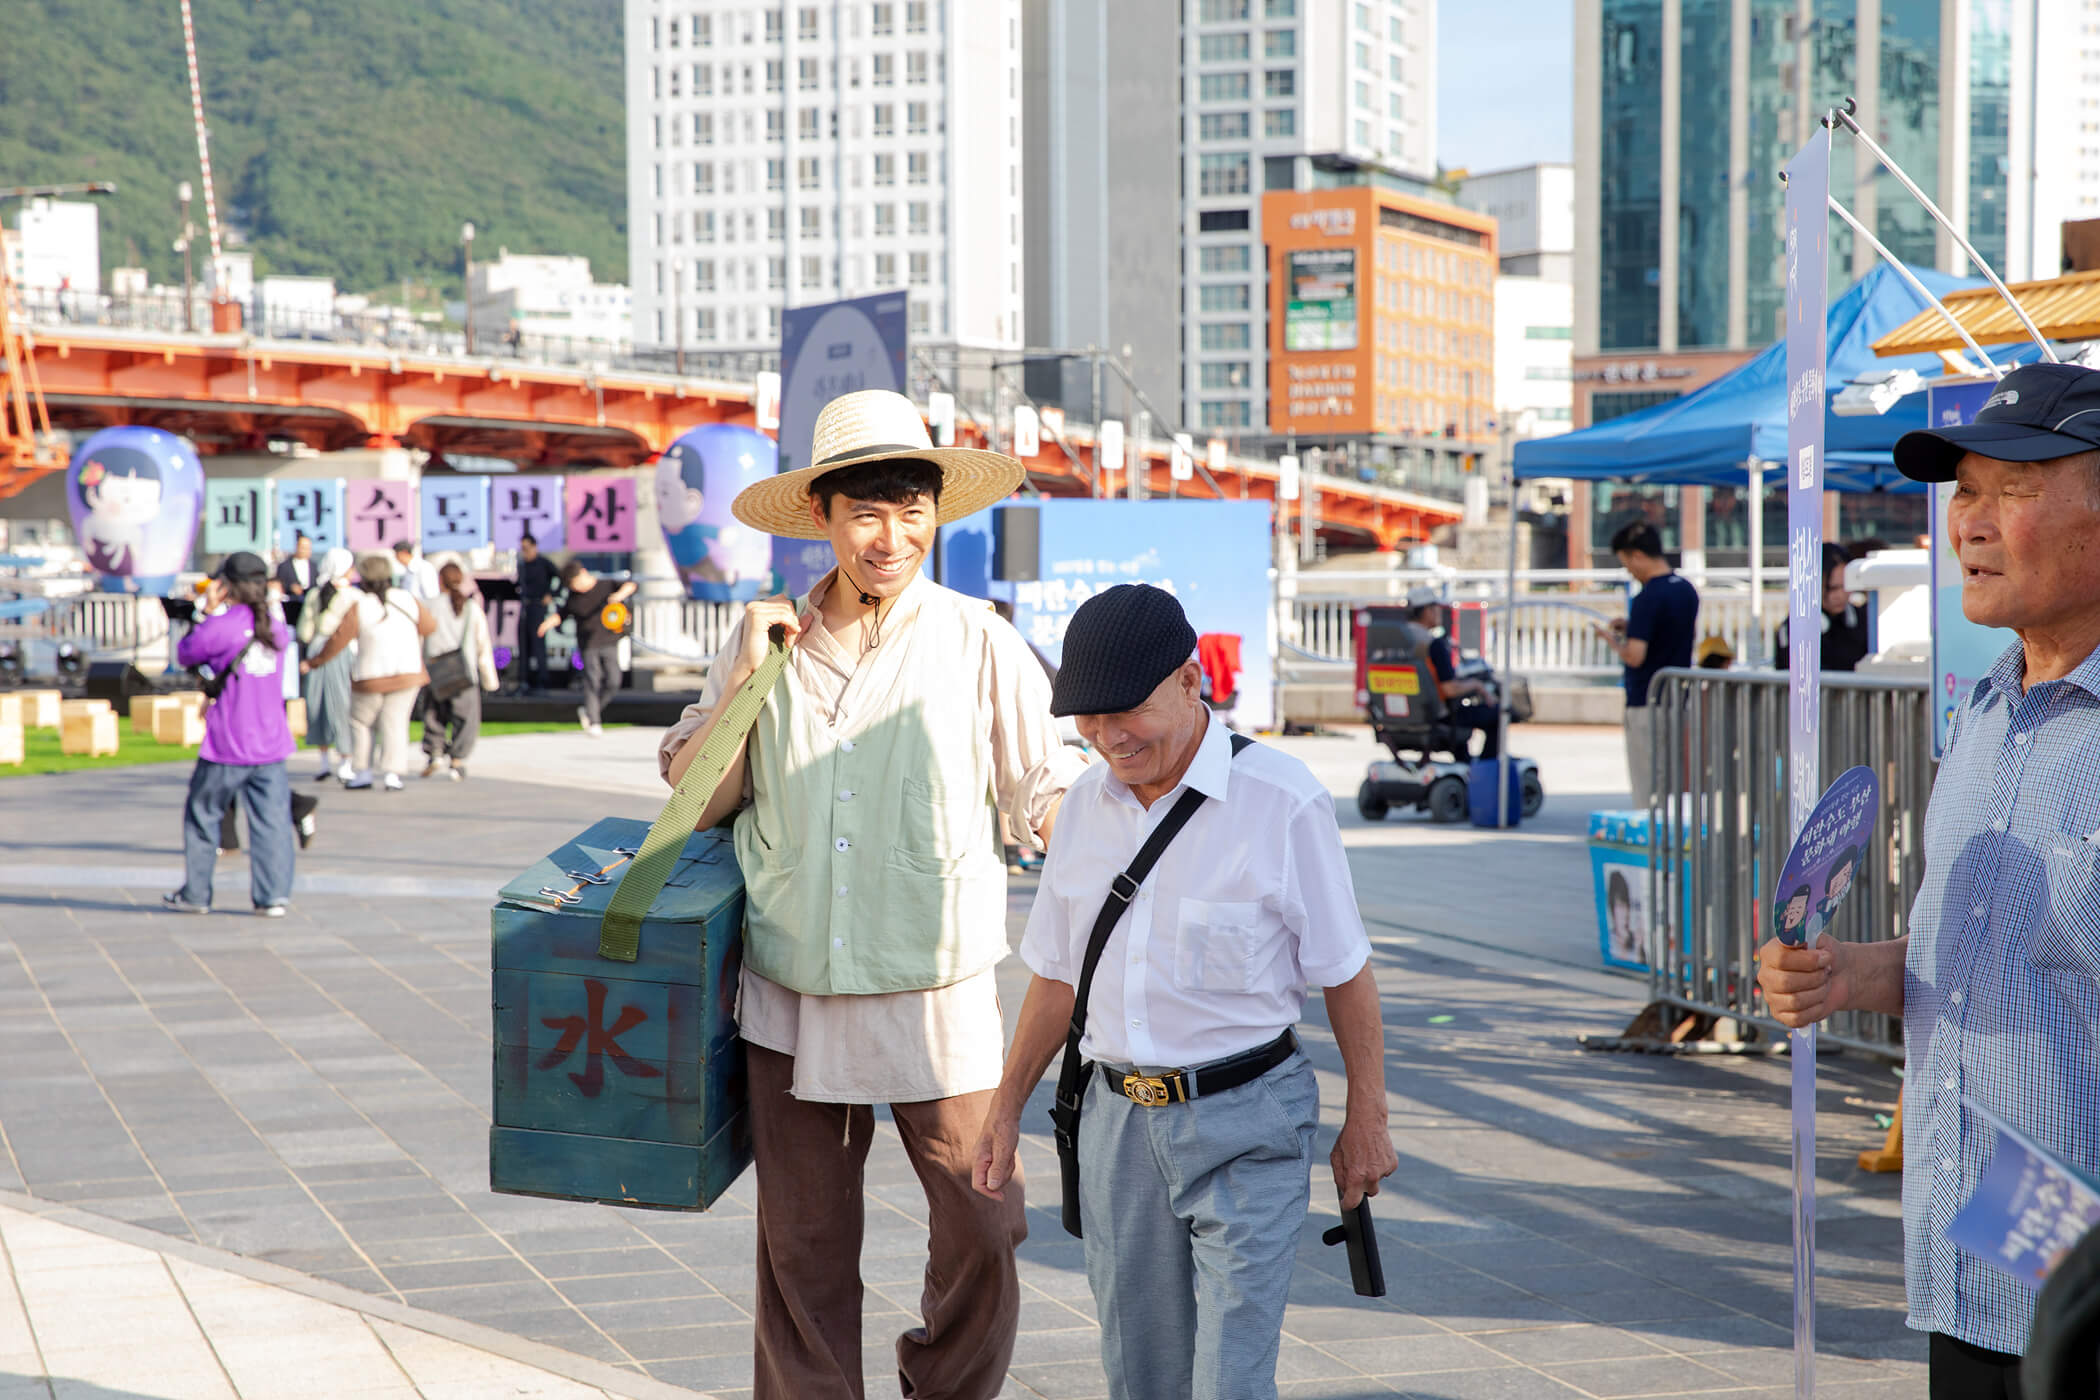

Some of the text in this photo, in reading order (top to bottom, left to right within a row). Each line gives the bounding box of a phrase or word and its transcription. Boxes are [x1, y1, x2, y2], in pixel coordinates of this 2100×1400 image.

[1792, 527, 1818, 618] 피란수도
[1799, 640, 1812, 733] 부산
[1800, 804, 1846, 845] 피란수도
[1850, 784, 1872, 813] 부산
[533, 978, 664, 1098] 水
